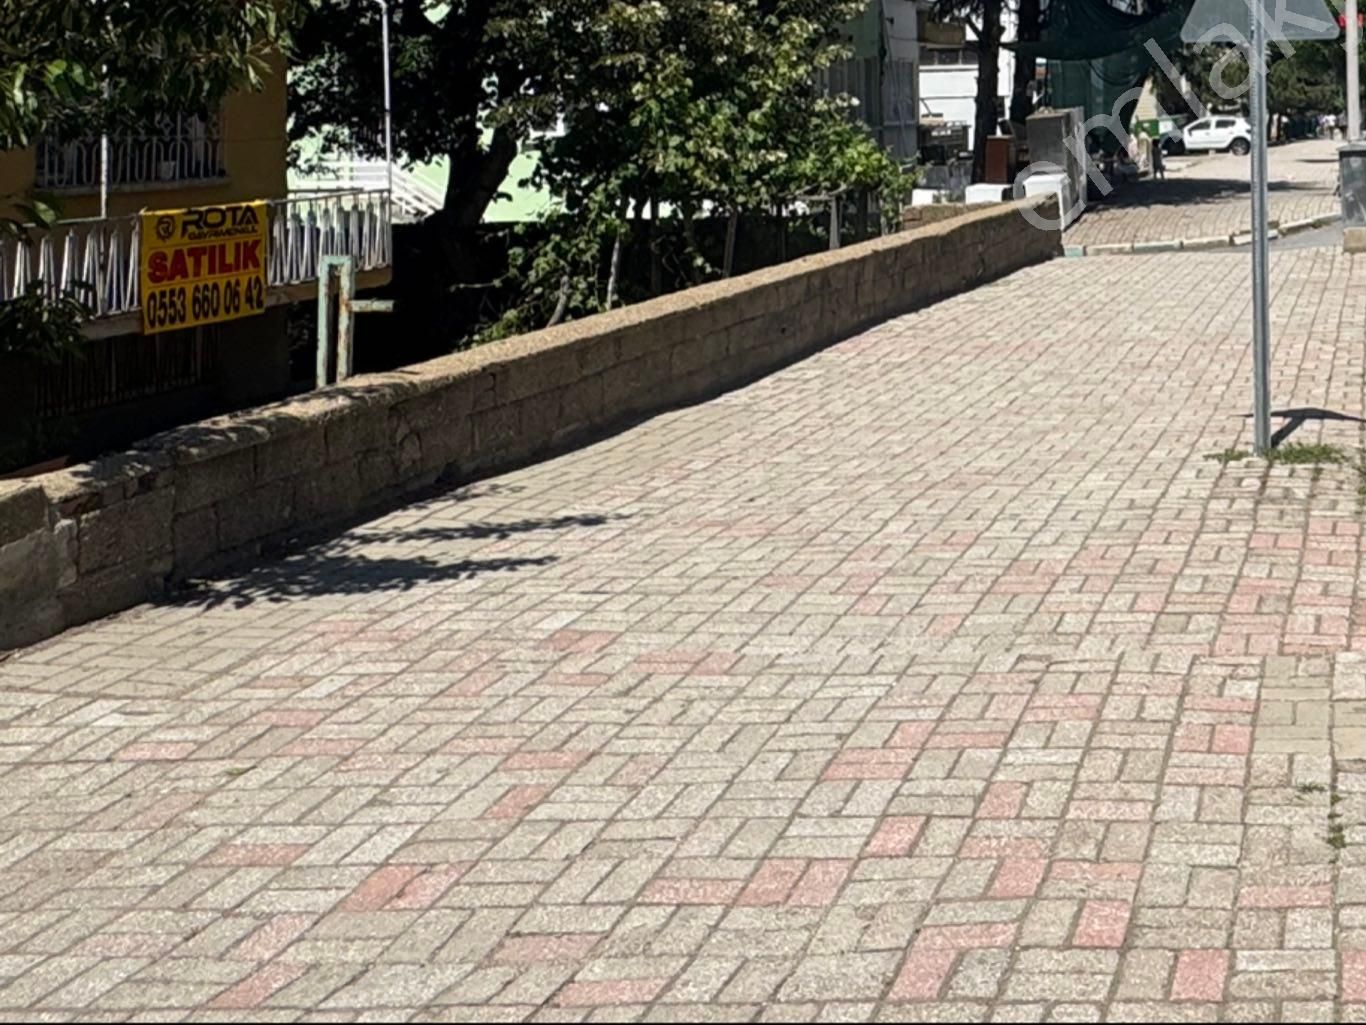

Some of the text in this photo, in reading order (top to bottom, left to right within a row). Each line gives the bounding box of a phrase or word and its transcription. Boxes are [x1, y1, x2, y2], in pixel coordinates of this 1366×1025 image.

[181, 205, 259, 238] ROTA
[147, 239, 261, 284] SATILIK
[147, 275, 264, 328] 0553 660 06 42
